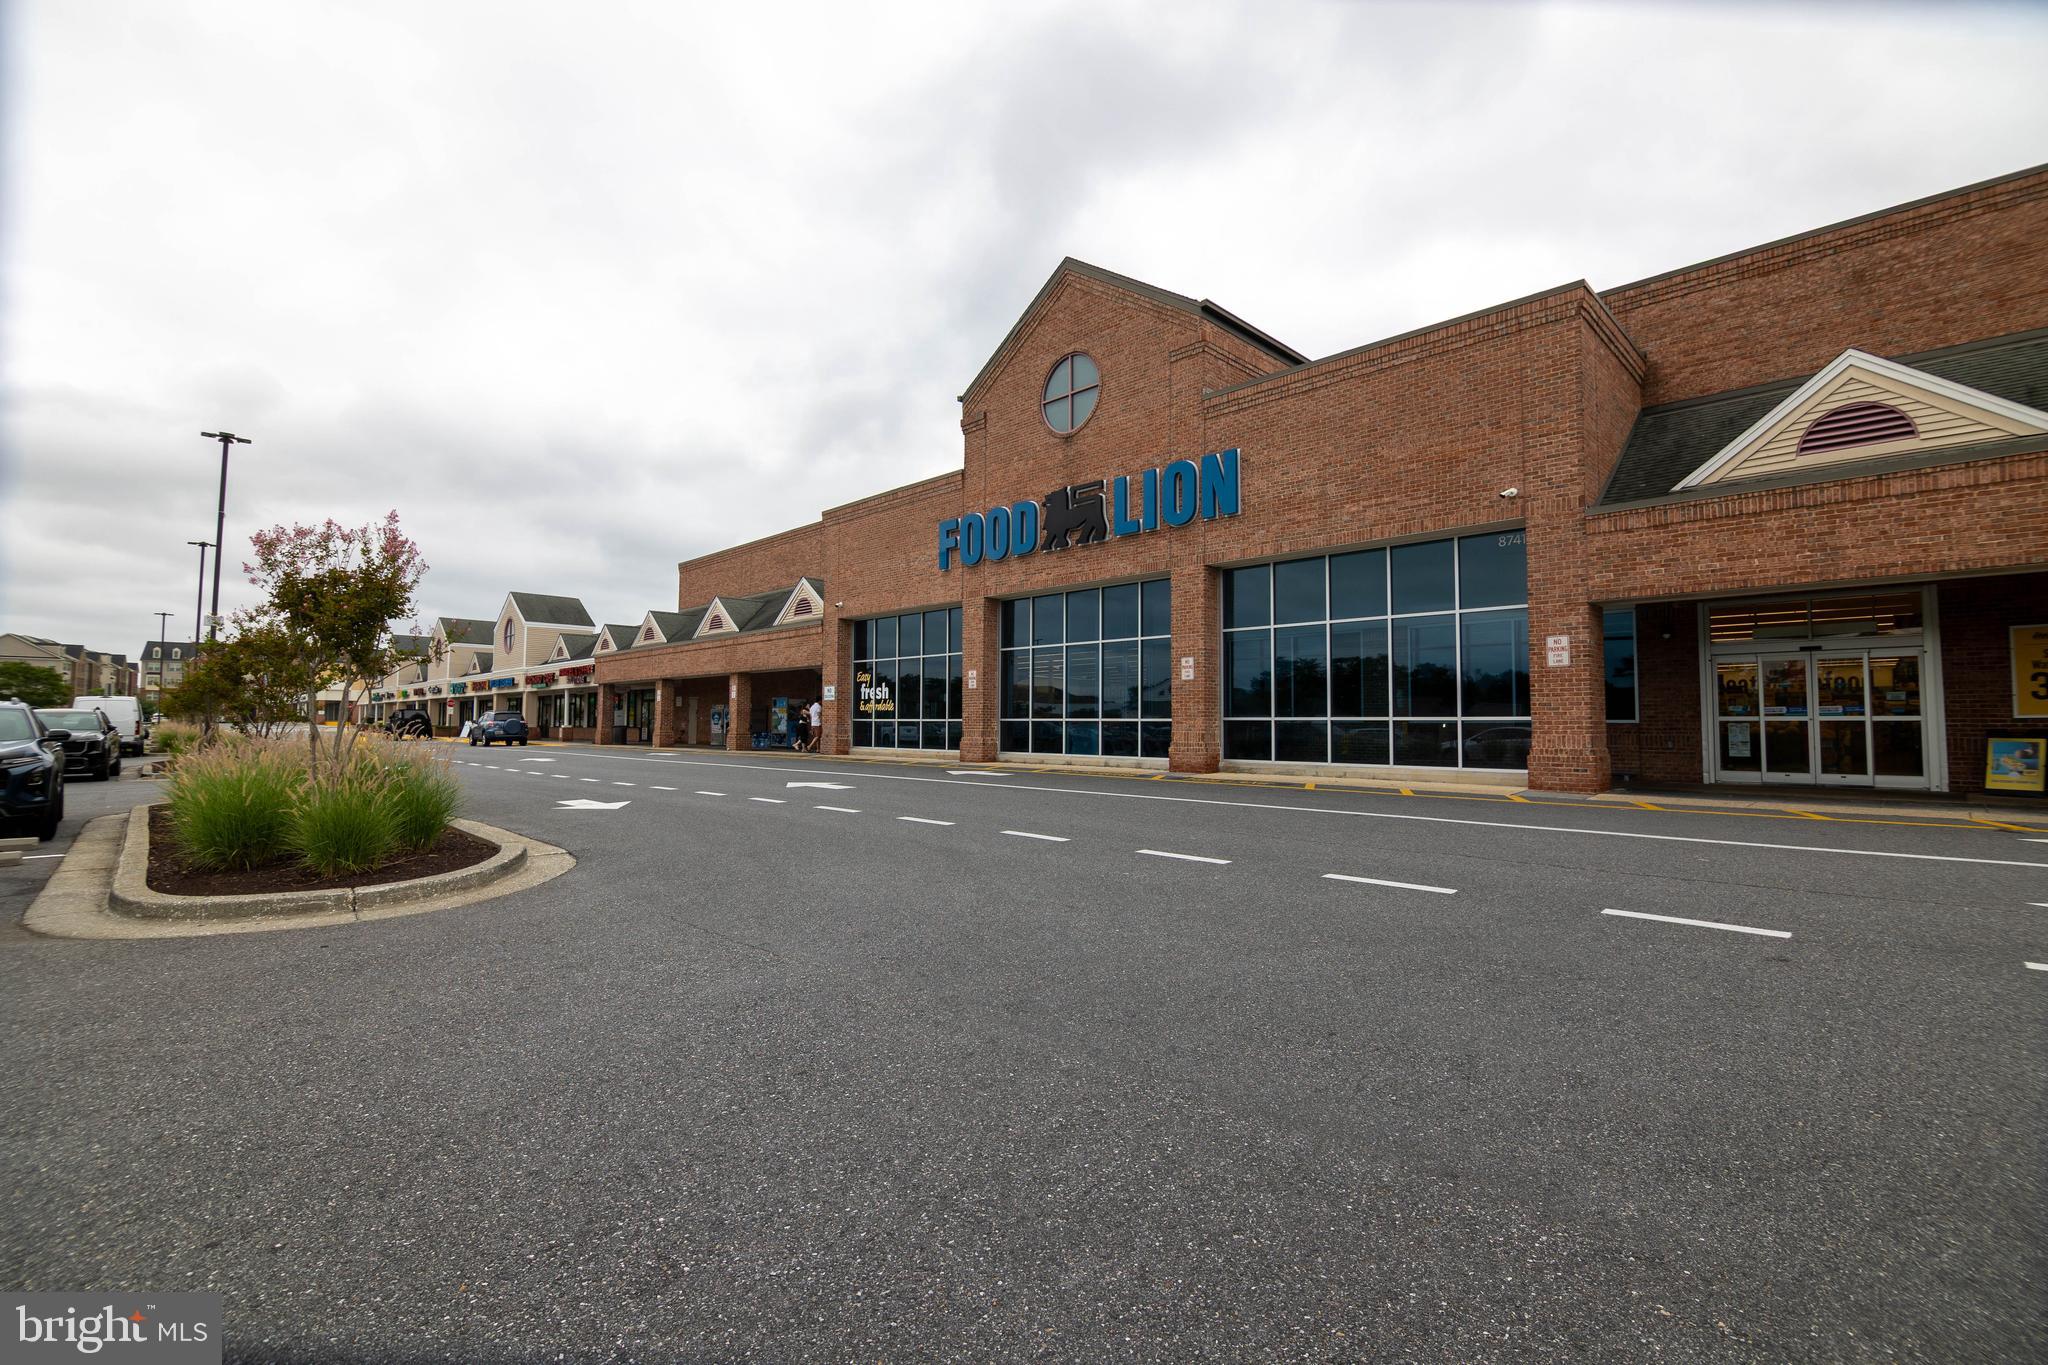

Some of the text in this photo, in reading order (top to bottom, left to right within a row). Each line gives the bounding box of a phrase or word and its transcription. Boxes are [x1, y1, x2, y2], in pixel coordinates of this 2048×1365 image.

[938, 448, 1241, 571] FOOD LION
[857, 671, 871, 687] Easy
[860, 682, 889, 699] fresh
[865, 699, 894, 714] affrdable
